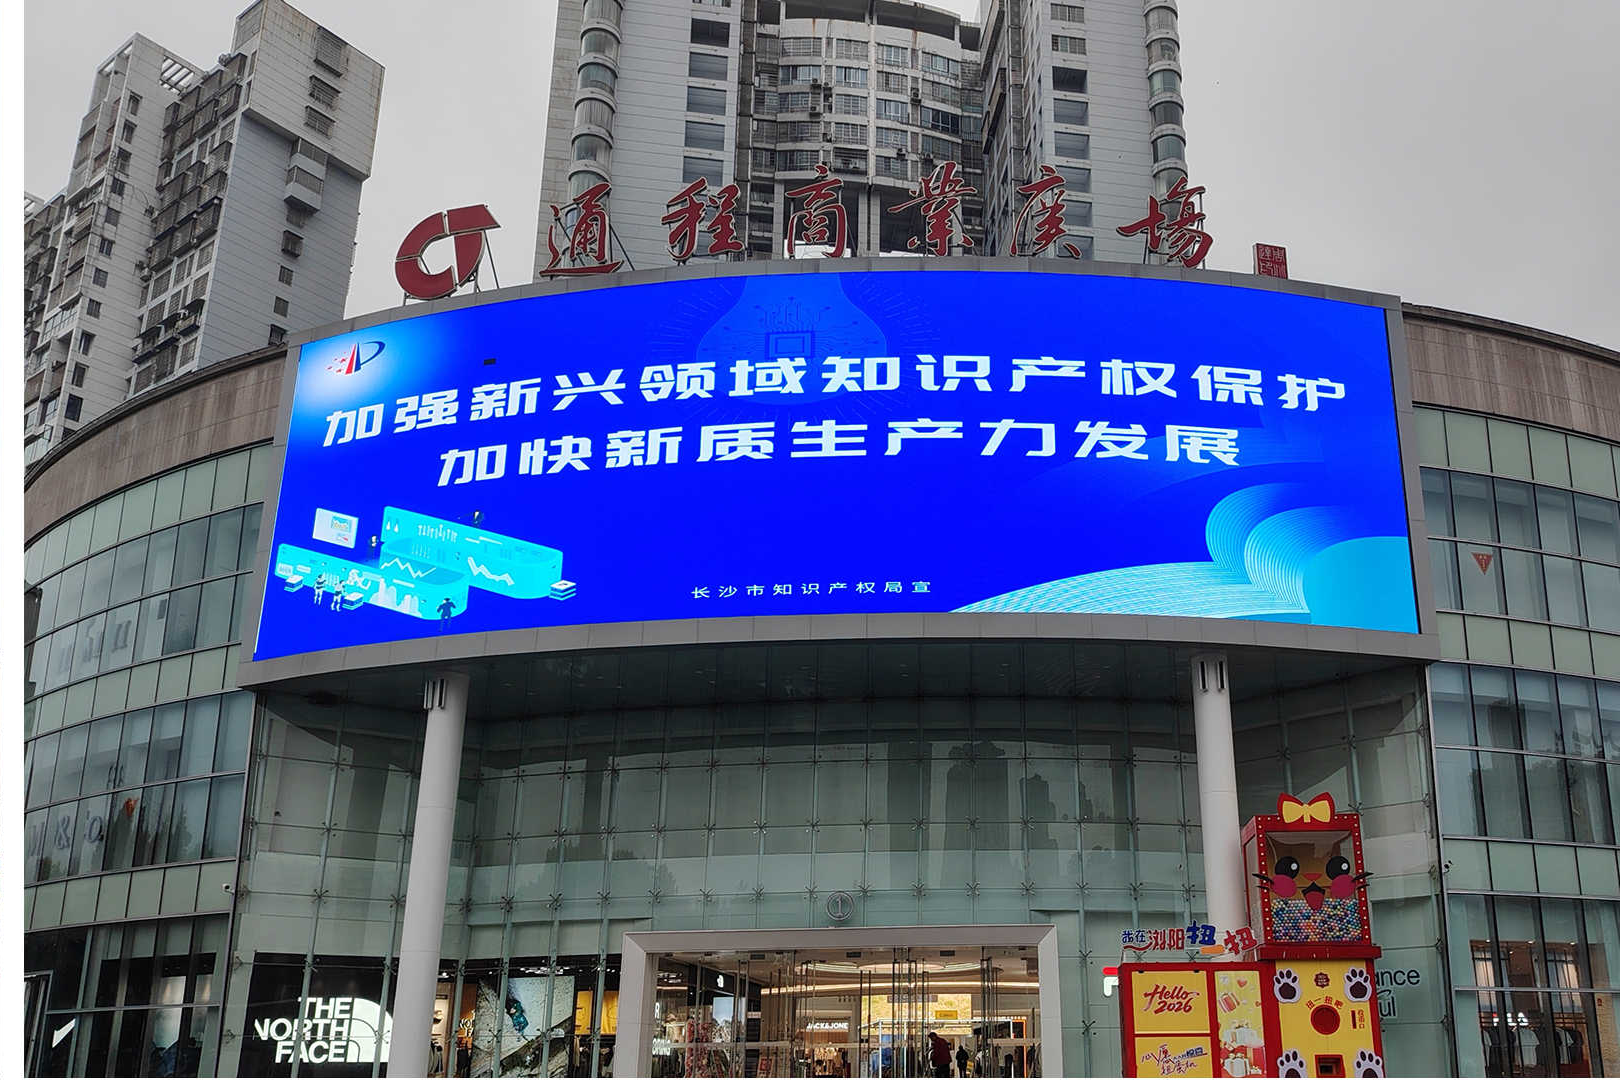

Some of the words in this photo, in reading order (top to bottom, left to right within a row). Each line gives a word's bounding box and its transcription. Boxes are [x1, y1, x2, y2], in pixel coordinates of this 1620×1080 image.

[323, 353, 1348, 448] 加强新兴领域知识产权保护
[437, 416, 1242, 488] 加快新质生产力发展
[691, 581, 931, 598] 长沙市知识产权局宣
[298, 997, 353, 1019] THE
[1142, 983, 1200, 1012] Hello
[1153, 997, 1194, 1015] 2026
[254, 1017, 350, 1041] NORTH
[275, 1040, 346, 1064] FACE
